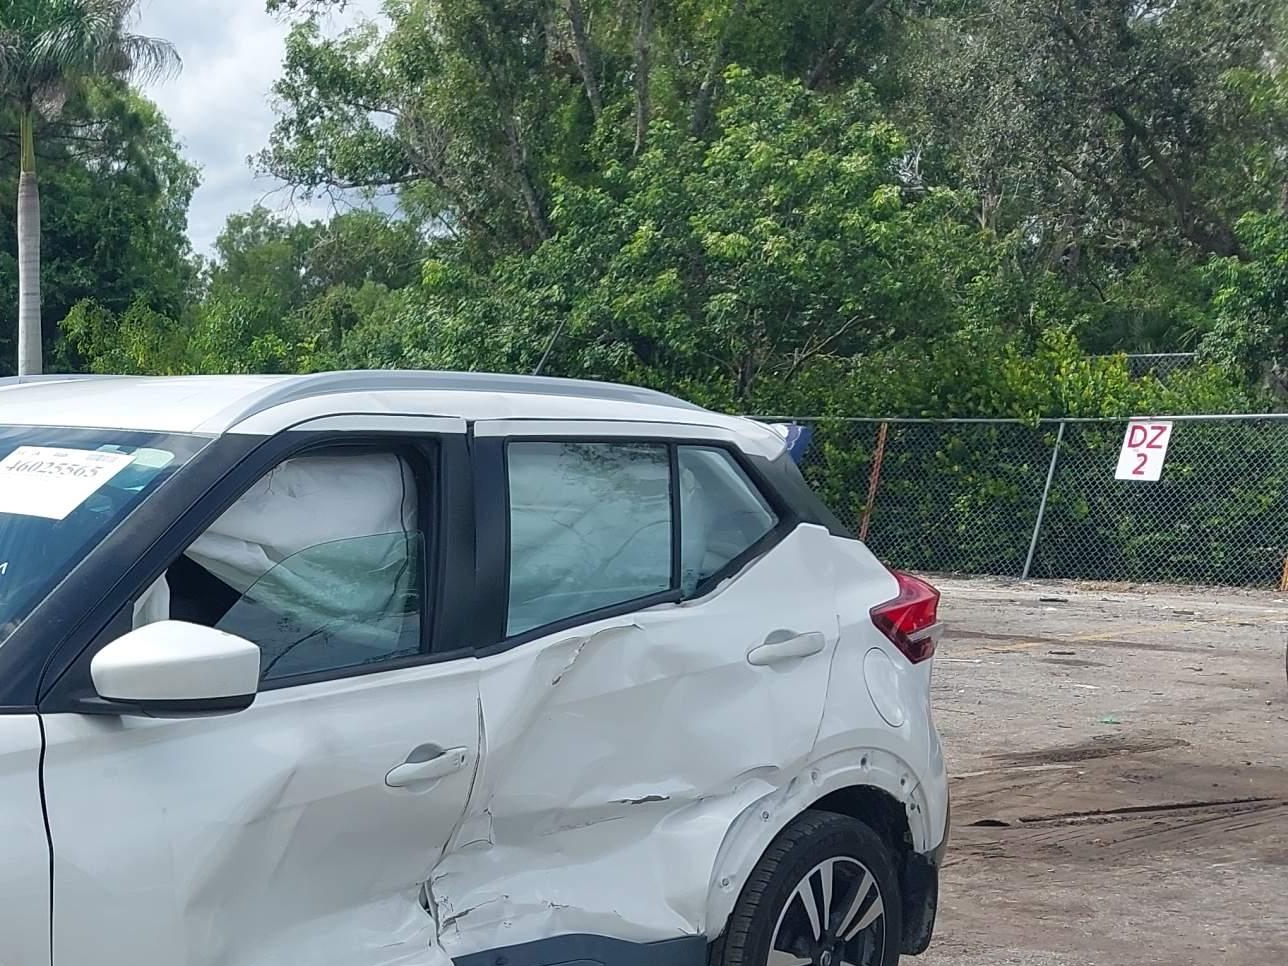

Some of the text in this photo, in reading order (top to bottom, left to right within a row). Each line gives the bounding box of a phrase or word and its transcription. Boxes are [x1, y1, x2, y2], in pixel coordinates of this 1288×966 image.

[1127, 425, 1167, 449] DZ
[6, 460, 105, 478] 46025565
[1132, 453, 1148, 475] 2
